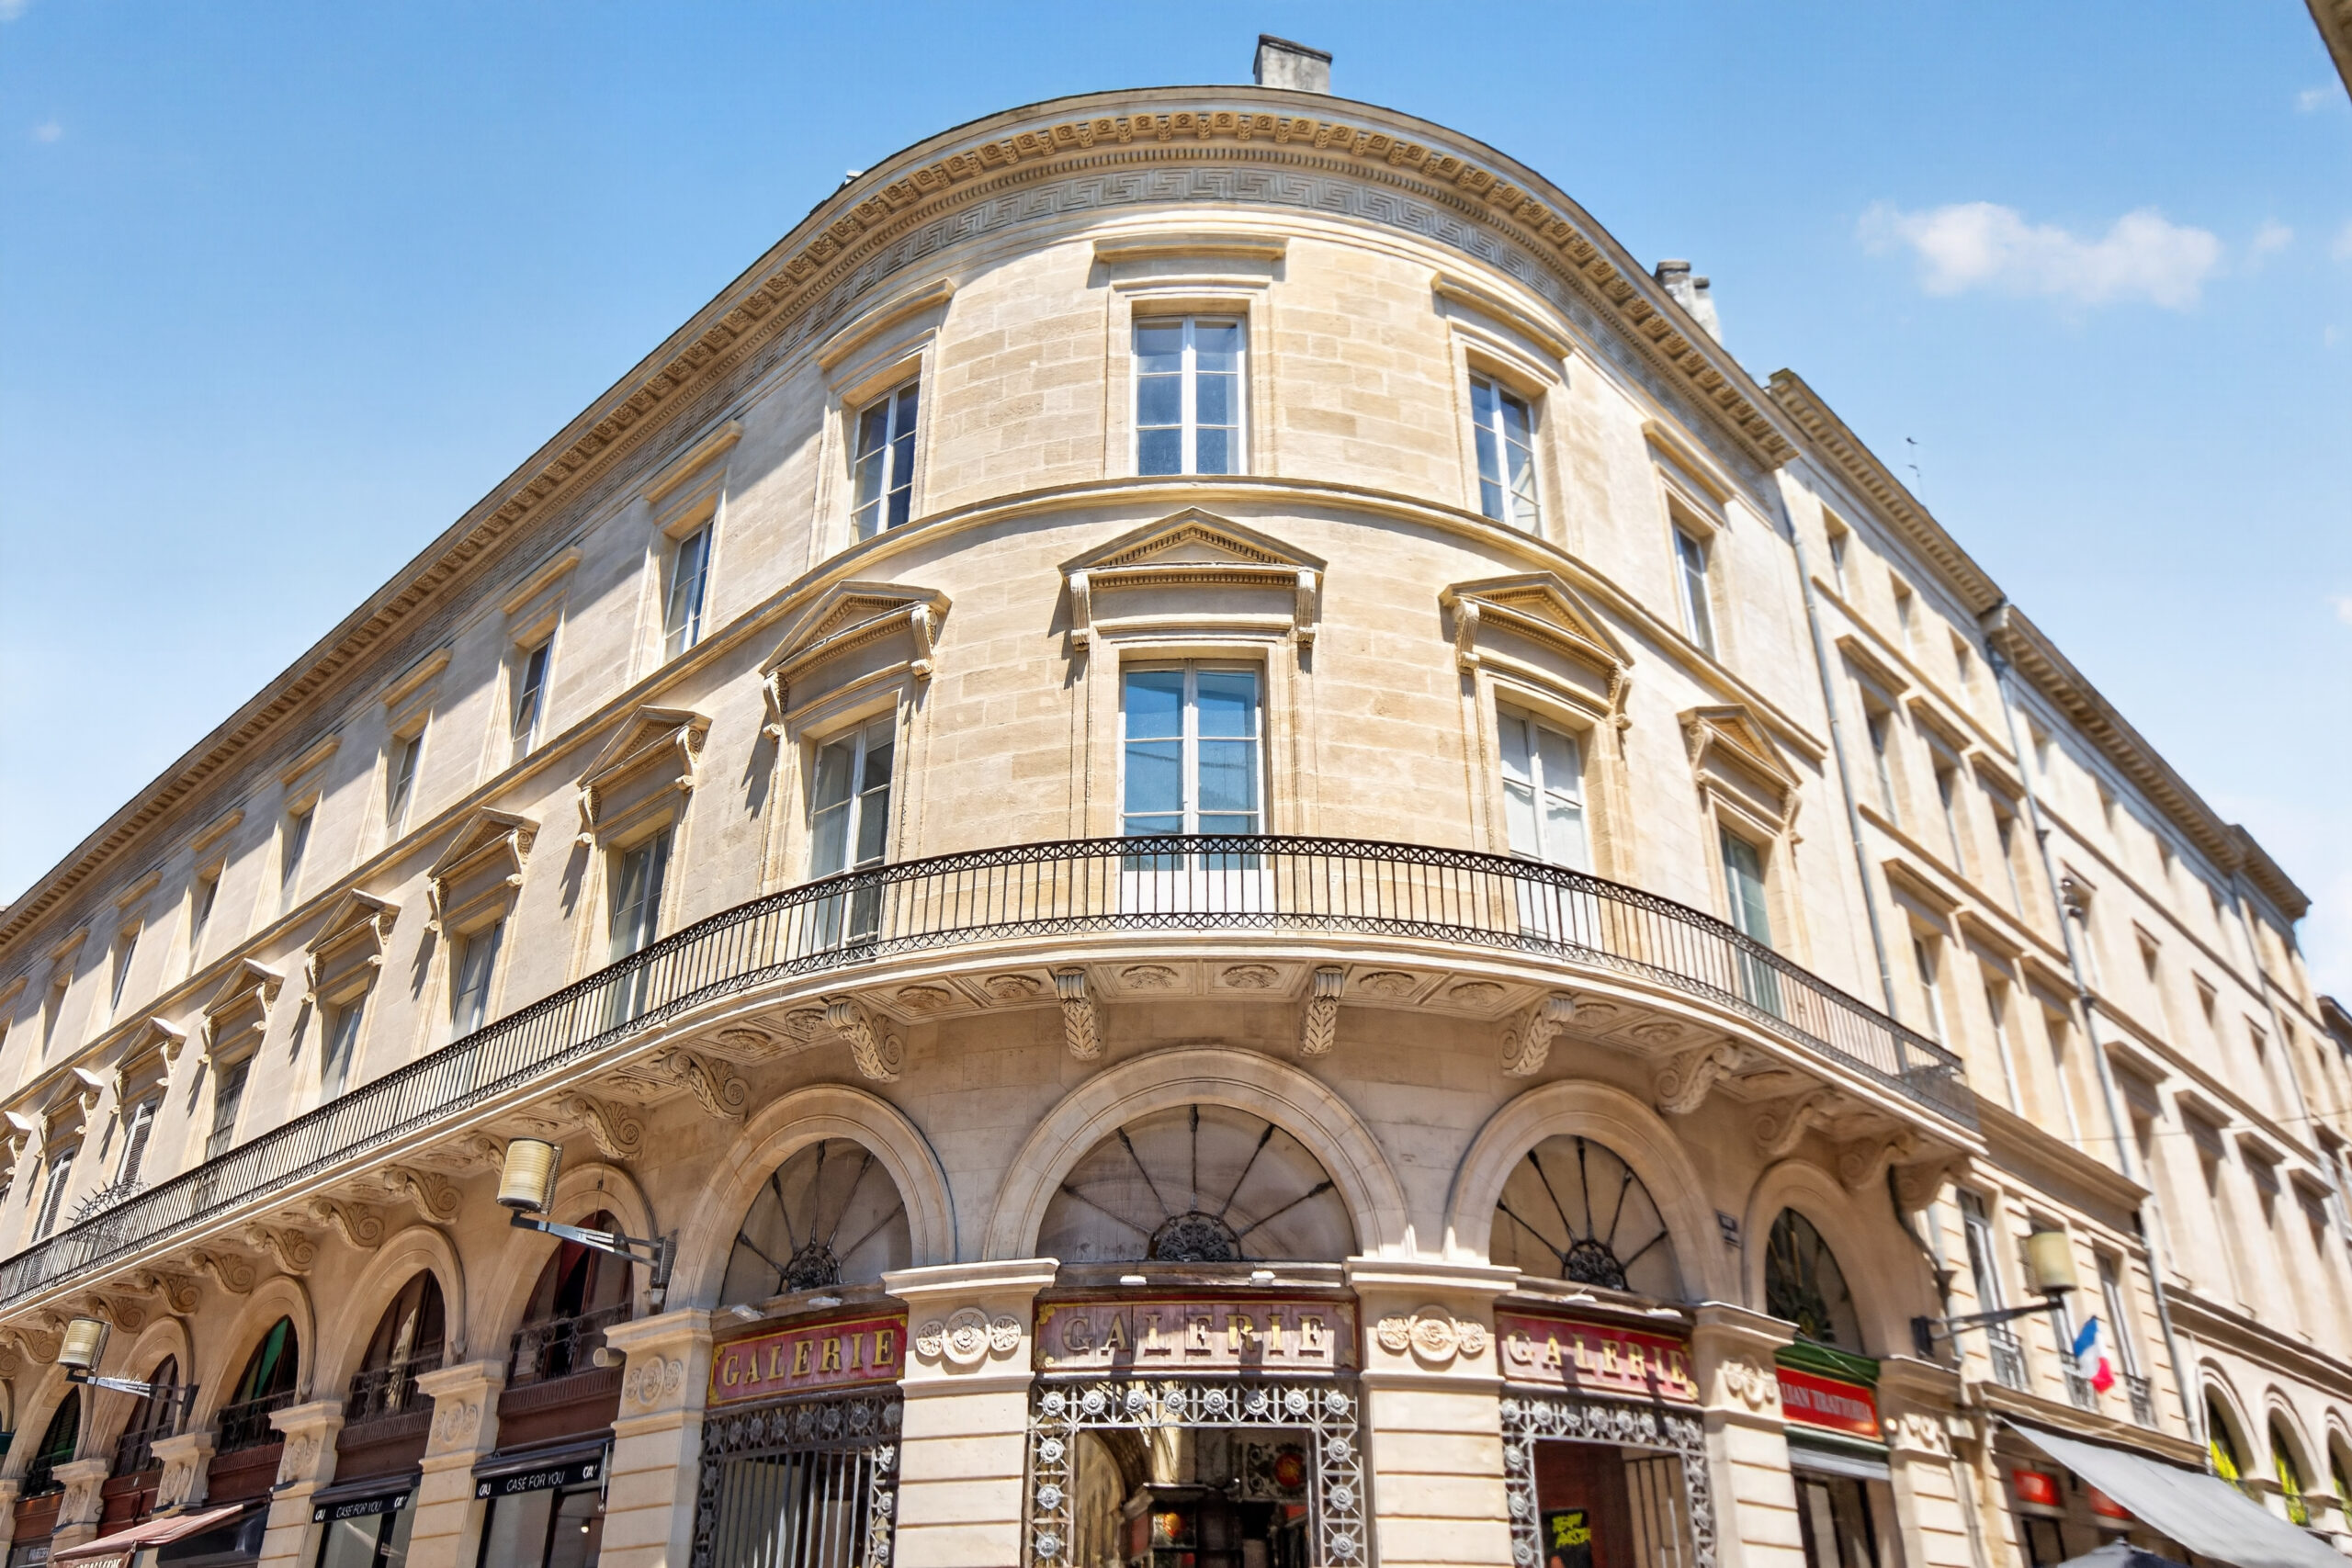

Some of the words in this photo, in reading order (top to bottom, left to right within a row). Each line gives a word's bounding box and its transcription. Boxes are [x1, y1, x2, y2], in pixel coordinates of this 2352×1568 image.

[1061, 1314, 1326, 1354] GALERIE
[722, 1328, 895, 1387] GALERIE
[1506, 1328, 1689, 1384] GALERIE
[506, 1476, 526, 1493] CASE
[528, 1472, 546, 1488] FOR
[548, 1471, 566, 1485] YOU
[336, 1504, 353, 1518] CASE
[353, 1501, 368, 1515] FOR
[368, 1499, 383, 1513] YOU
